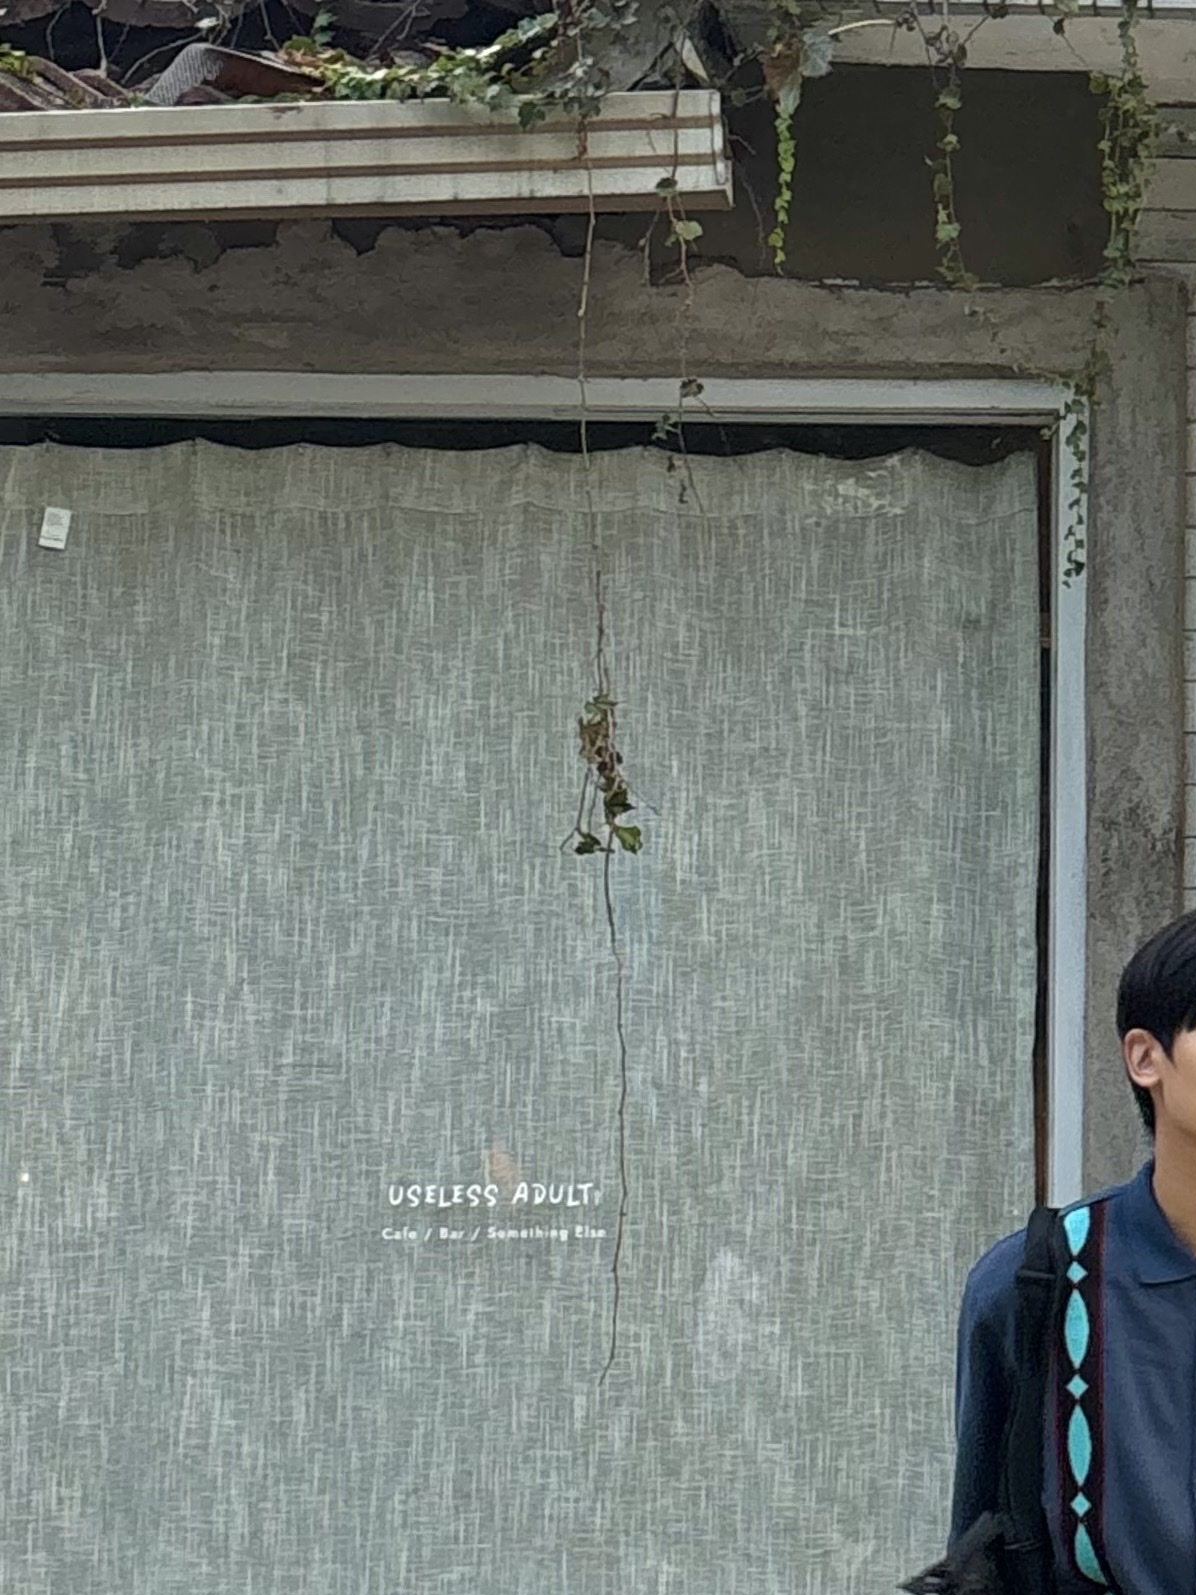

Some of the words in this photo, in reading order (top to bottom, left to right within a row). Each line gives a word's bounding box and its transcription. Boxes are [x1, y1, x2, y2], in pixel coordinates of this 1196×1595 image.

[388, 1184, 499, 1208] USELESS
[511, 1181, 594, 1207] ADULT
[381, 1226, 417, 1240] Cafe
[439, 1227, 465, 1240] Bar
[486, 1225, 568, 1242] Something
[575, 1225, 607, 1239] Else
